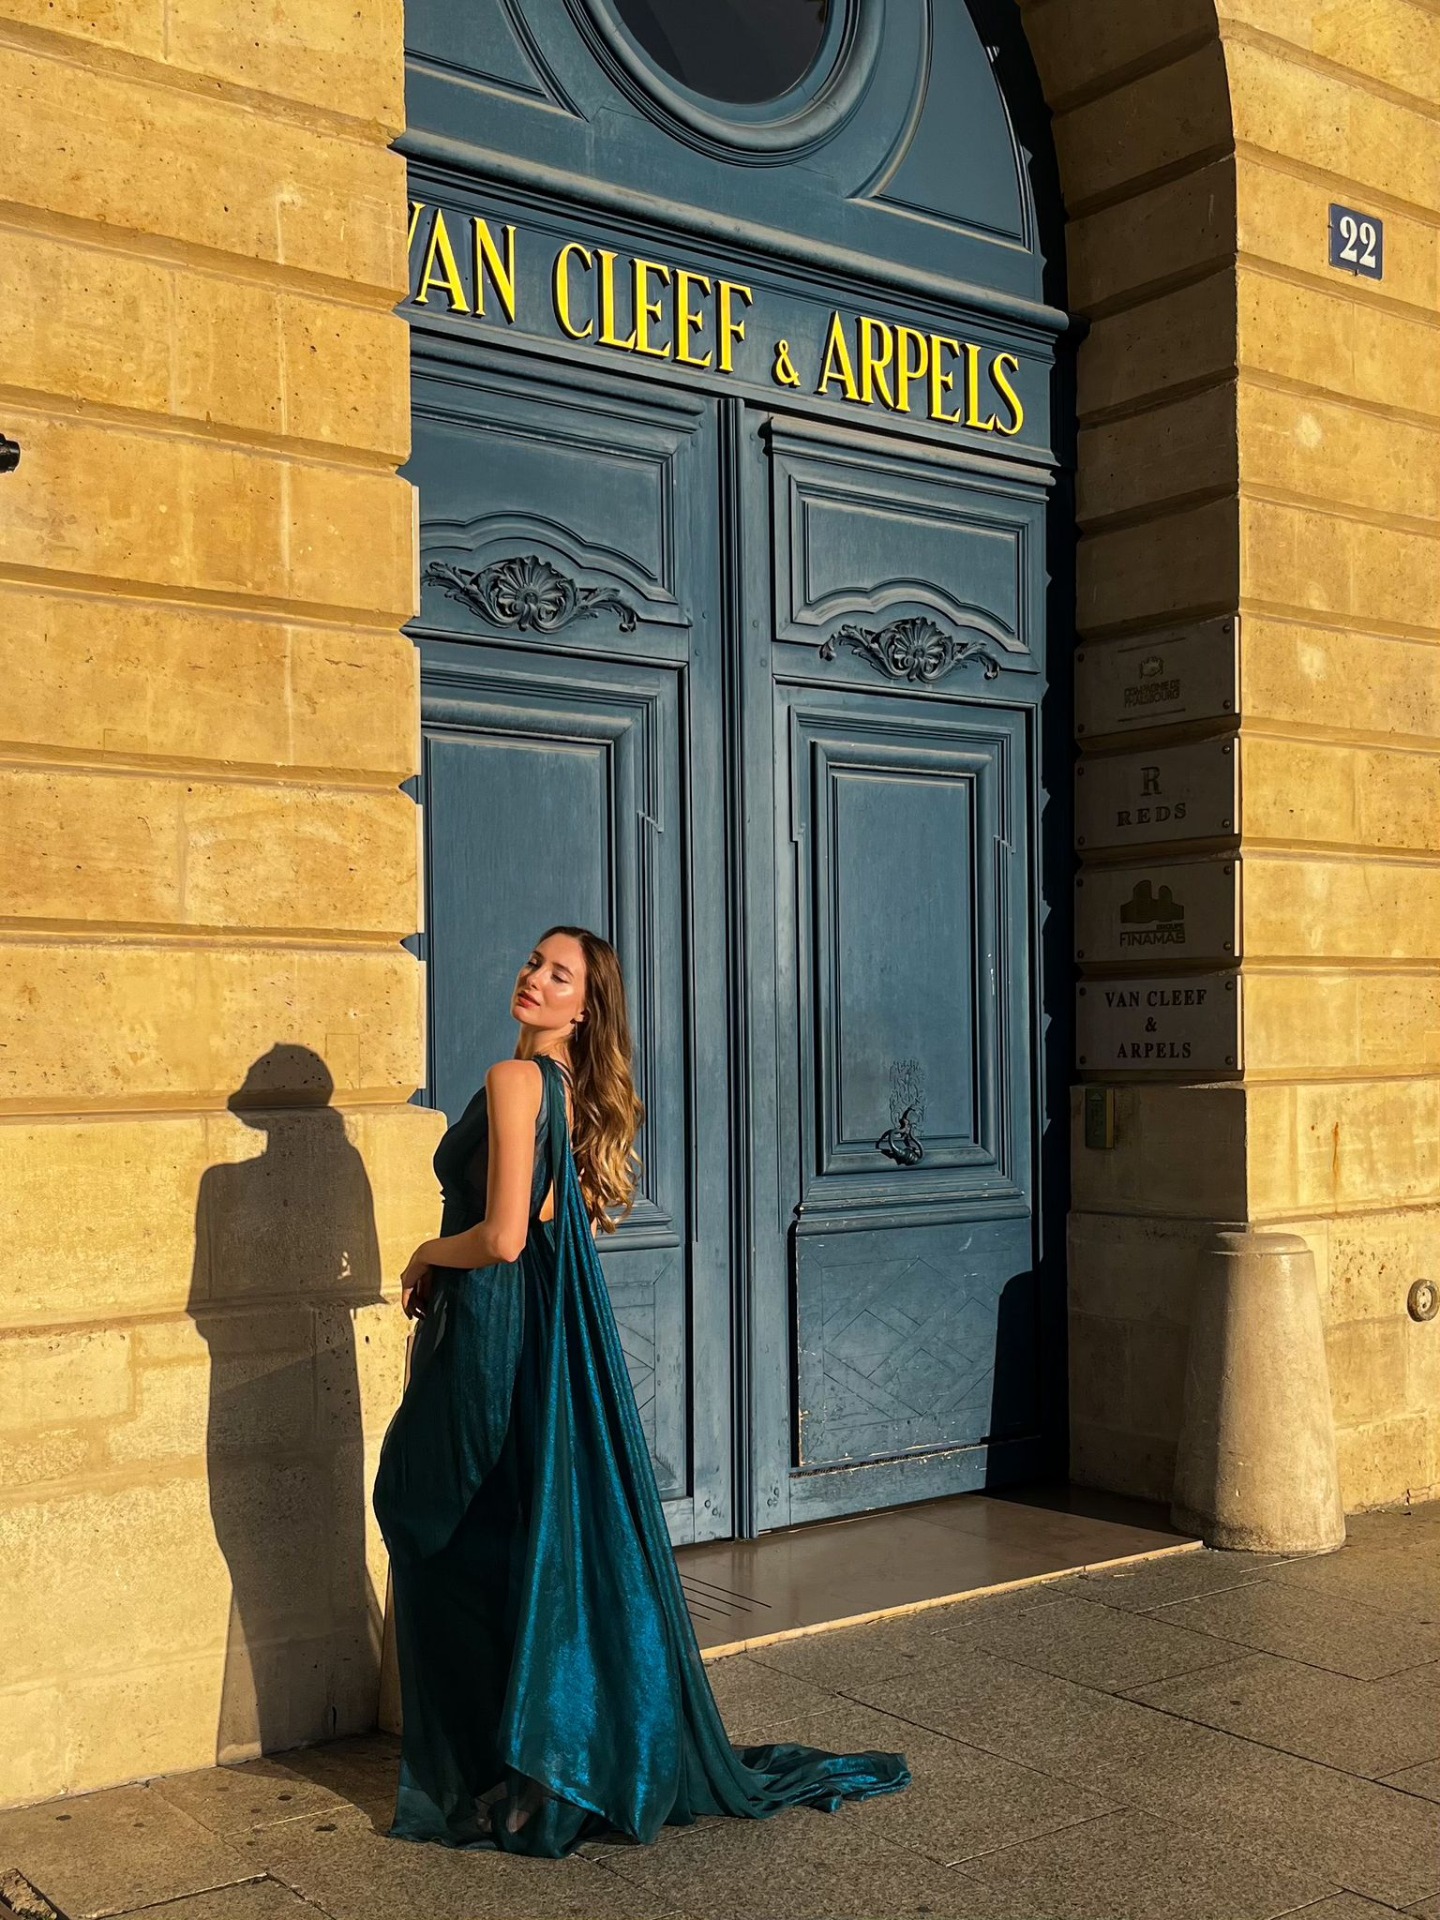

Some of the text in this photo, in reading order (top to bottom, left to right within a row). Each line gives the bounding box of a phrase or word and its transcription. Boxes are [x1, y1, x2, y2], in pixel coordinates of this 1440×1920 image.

[1340, 216, 1376, 269] 22
[554, 242, 754, 372] CLEEF
[773, 338, 801, 387] &
[817, 311, 1025, 436] ARPELS
[1140, 766, 1162, 797] R
[1116, 802, 1187, 827] REDS
[1119, 931, 1186, 947] FINAMAS
[1104, 989, 1207, 1008] VAN CLEEF
[1145, 1016, 1157, 1032] &
[1116, 1042, 1191, 1059] ARPELS
